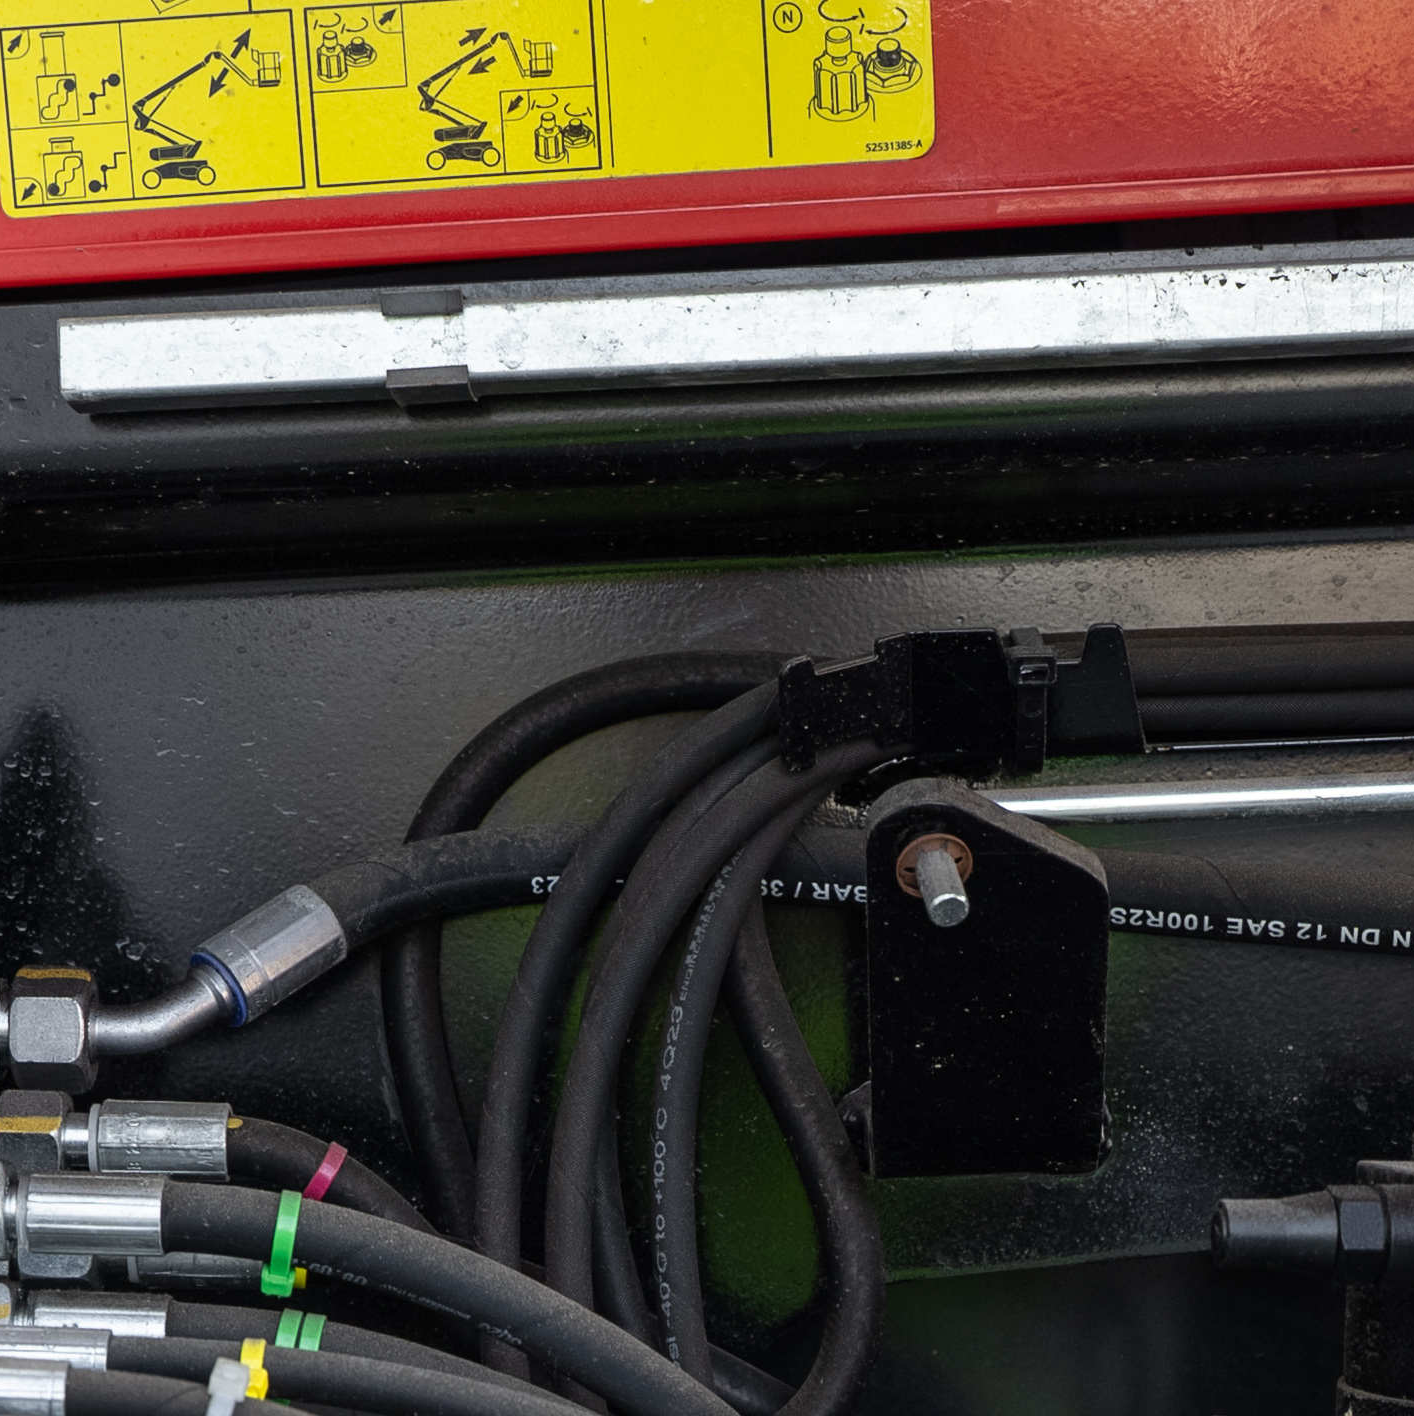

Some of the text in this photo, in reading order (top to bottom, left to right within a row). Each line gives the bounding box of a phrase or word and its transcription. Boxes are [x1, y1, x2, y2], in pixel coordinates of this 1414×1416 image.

[782, 10, 793, 24] N
[865, 139, 923, 152] 52531385-A
[1227, 917, 1285, 938] SAE
[1296, 923, 1327, 941] 12
[1340, 927, 1380, 946] DN
